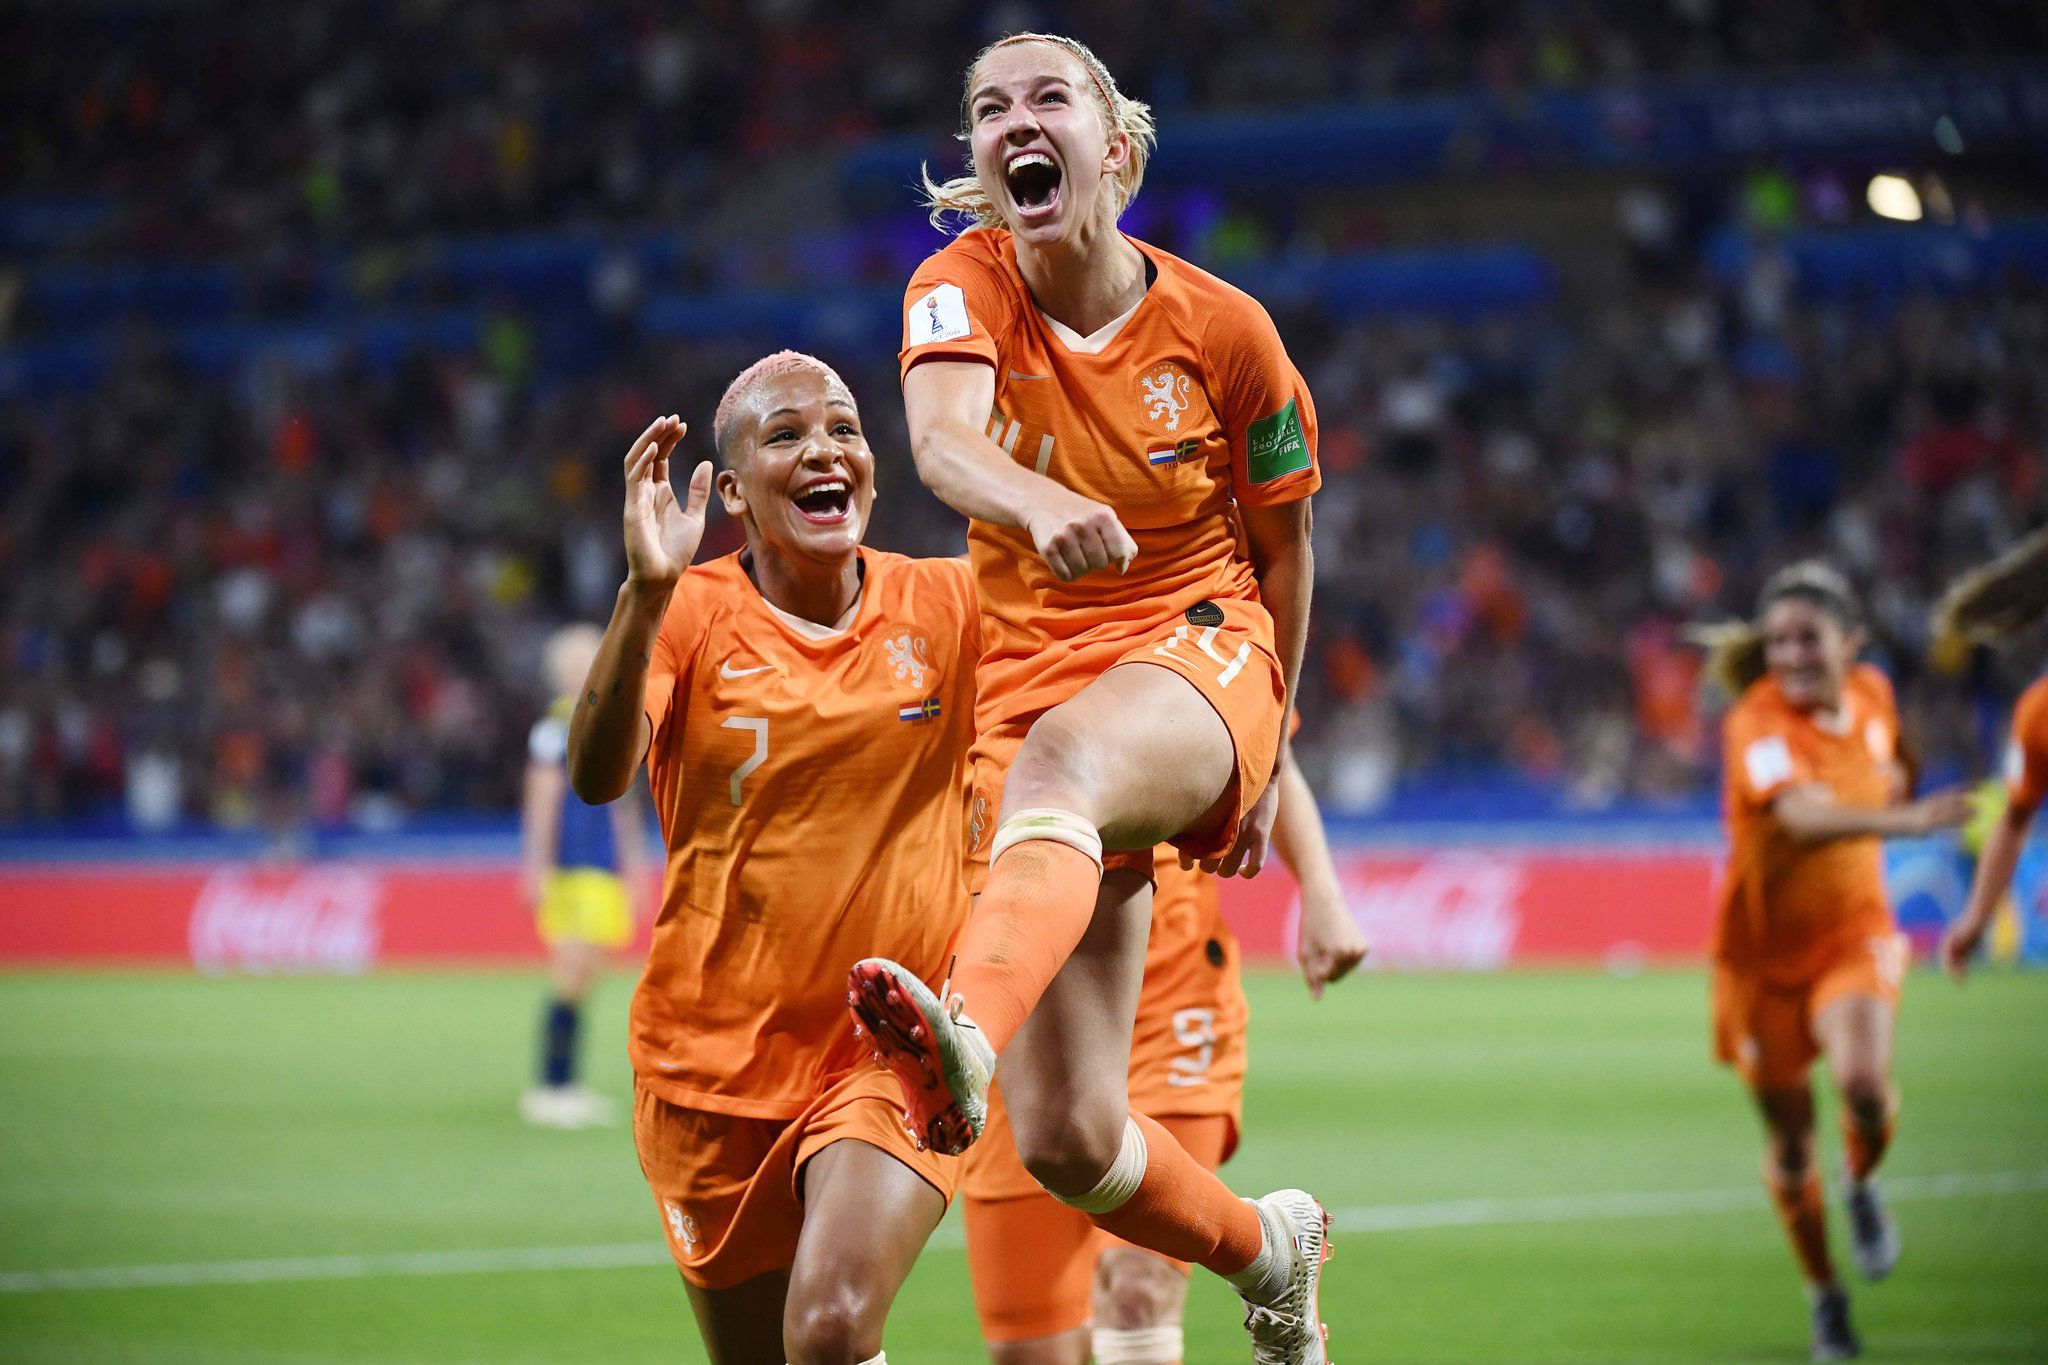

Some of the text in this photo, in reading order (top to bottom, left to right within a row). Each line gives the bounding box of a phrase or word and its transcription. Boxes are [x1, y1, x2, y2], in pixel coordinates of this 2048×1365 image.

[1278, 440, 1300, 457] FIFA
[720, 715, 769, 807] 7
[1170, 1007, 1216, 1075] 9
